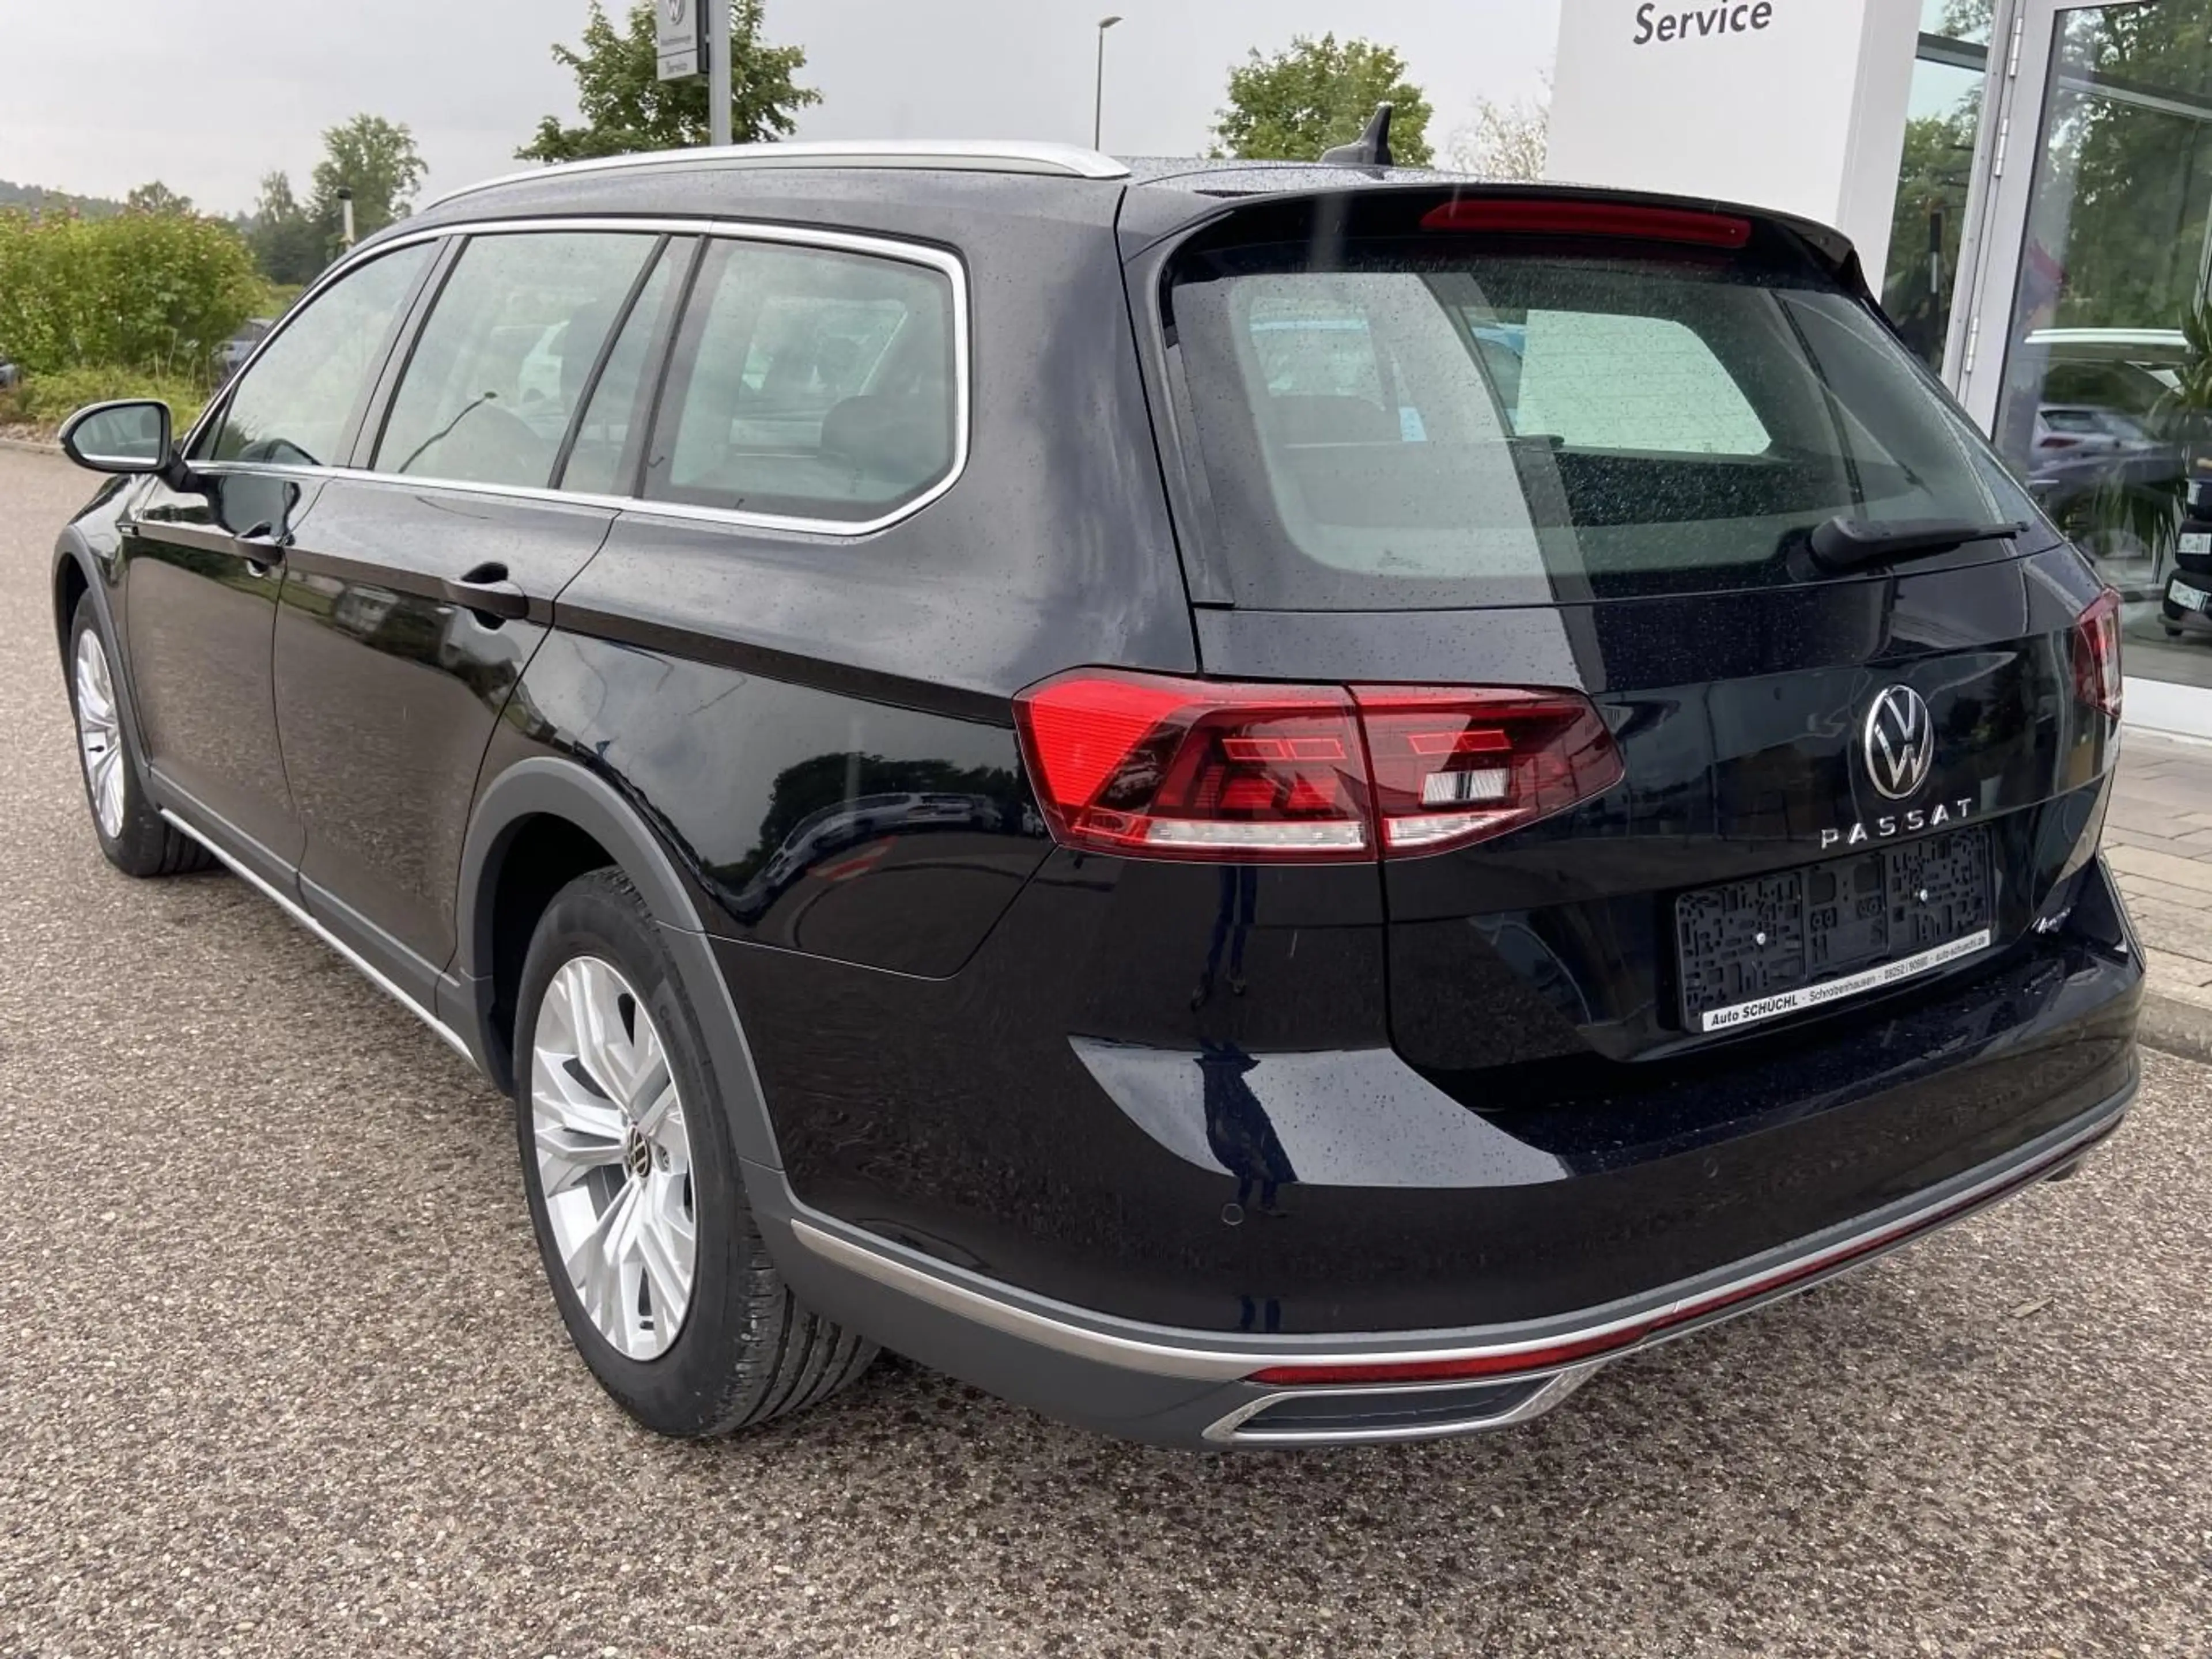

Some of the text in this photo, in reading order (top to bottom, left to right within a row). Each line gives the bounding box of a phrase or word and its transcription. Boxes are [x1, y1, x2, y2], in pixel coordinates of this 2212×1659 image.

[1632, 0, 1773, 44] Service
[1821, 798, 1972, 850] PASSAT
[1711, 1012, 1740, 1026] Auto
[1742, 995, 1798, 1018] SCHÜCHL
